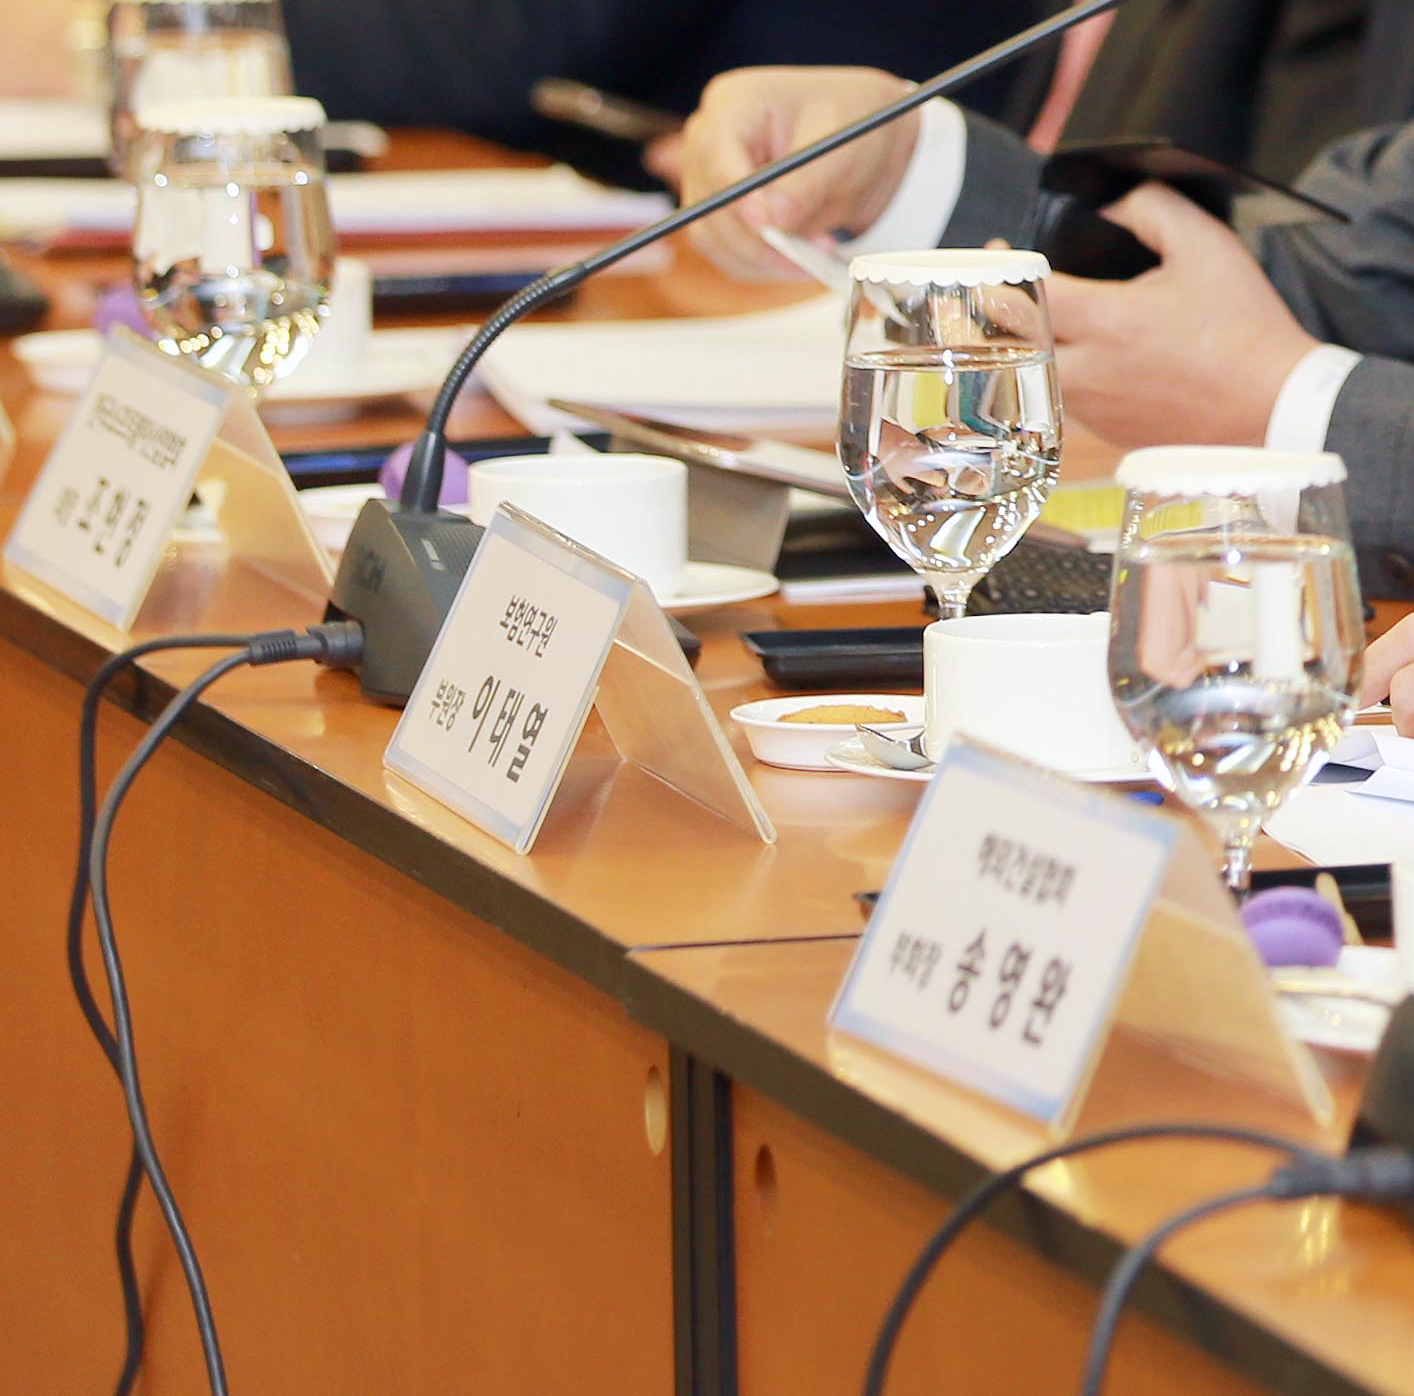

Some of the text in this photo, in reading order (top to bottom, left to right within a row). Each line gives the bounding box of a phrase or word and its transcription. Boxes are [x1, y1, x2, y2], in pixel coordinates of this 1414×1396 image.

[498, 594, 558, 658] 보험연구원
[429, 675, 549, 784] 부원장 이태열
[946, 926, 1073, 1049] 송영완
